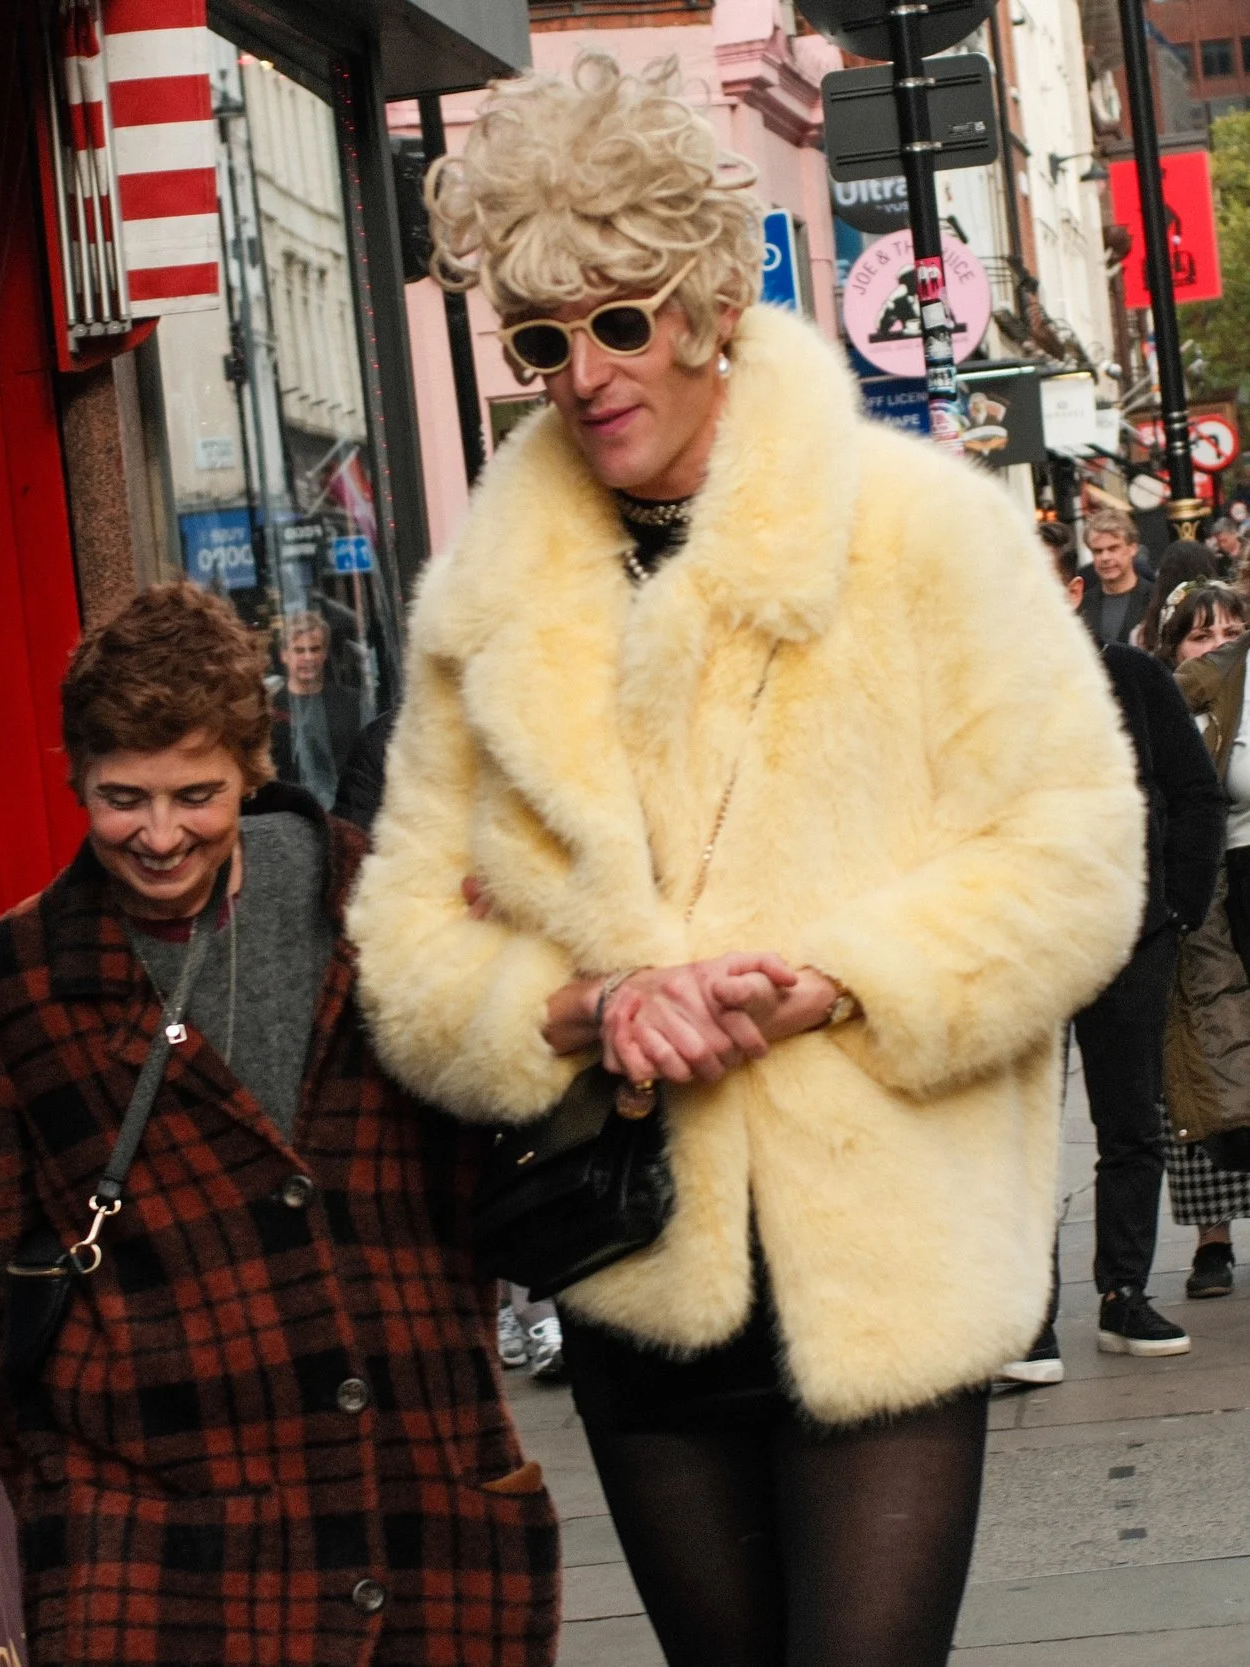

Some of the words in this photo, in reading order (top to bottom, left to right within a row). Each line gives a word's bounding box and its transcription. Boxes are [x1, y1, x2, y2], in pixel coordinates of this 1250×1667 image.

[851, 261, 879, 296] JOE
[875, 250, 890, 265] &
[891, 240, 914, 256] TH
